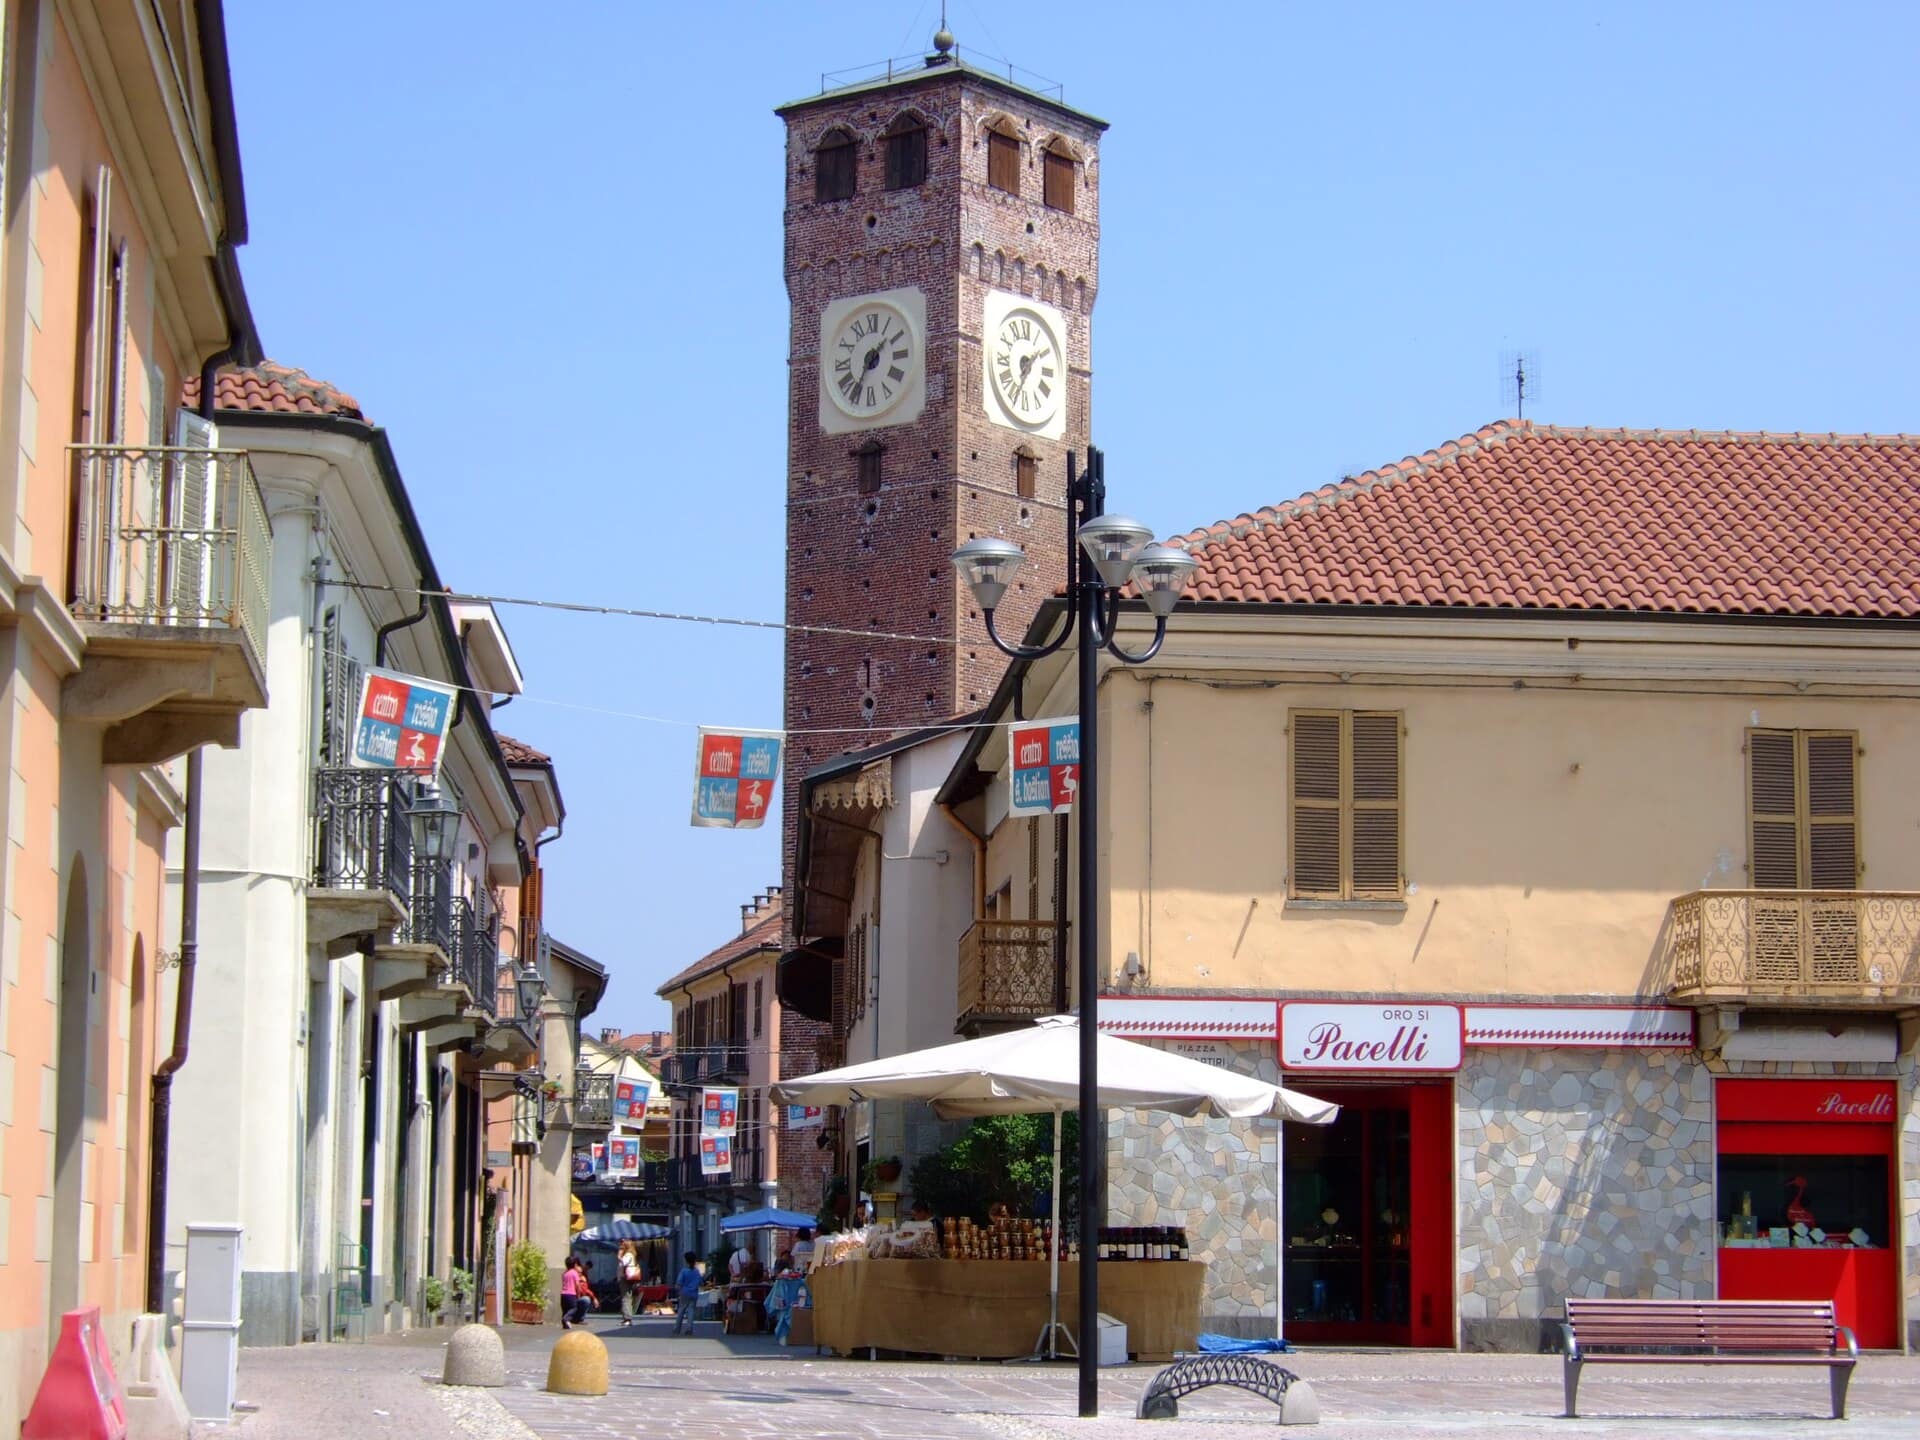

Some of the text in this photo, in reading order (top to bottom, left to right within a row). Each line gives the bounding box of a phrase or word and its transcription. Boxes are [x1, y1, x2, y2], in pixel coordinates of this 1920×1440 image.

[372, 691, 398, 719] centro
[709, 746, 733, 773] centro
[1021, 738, 1042, 765] centro
[1382, 1009, 1429, 1021] ORO SI
[1177, 1044, 1216, 1053] PIAZZA
[1303, 1022, 1429, 1062] Pacelli
[1816, 1092, 1893, 1115] Pacelli
